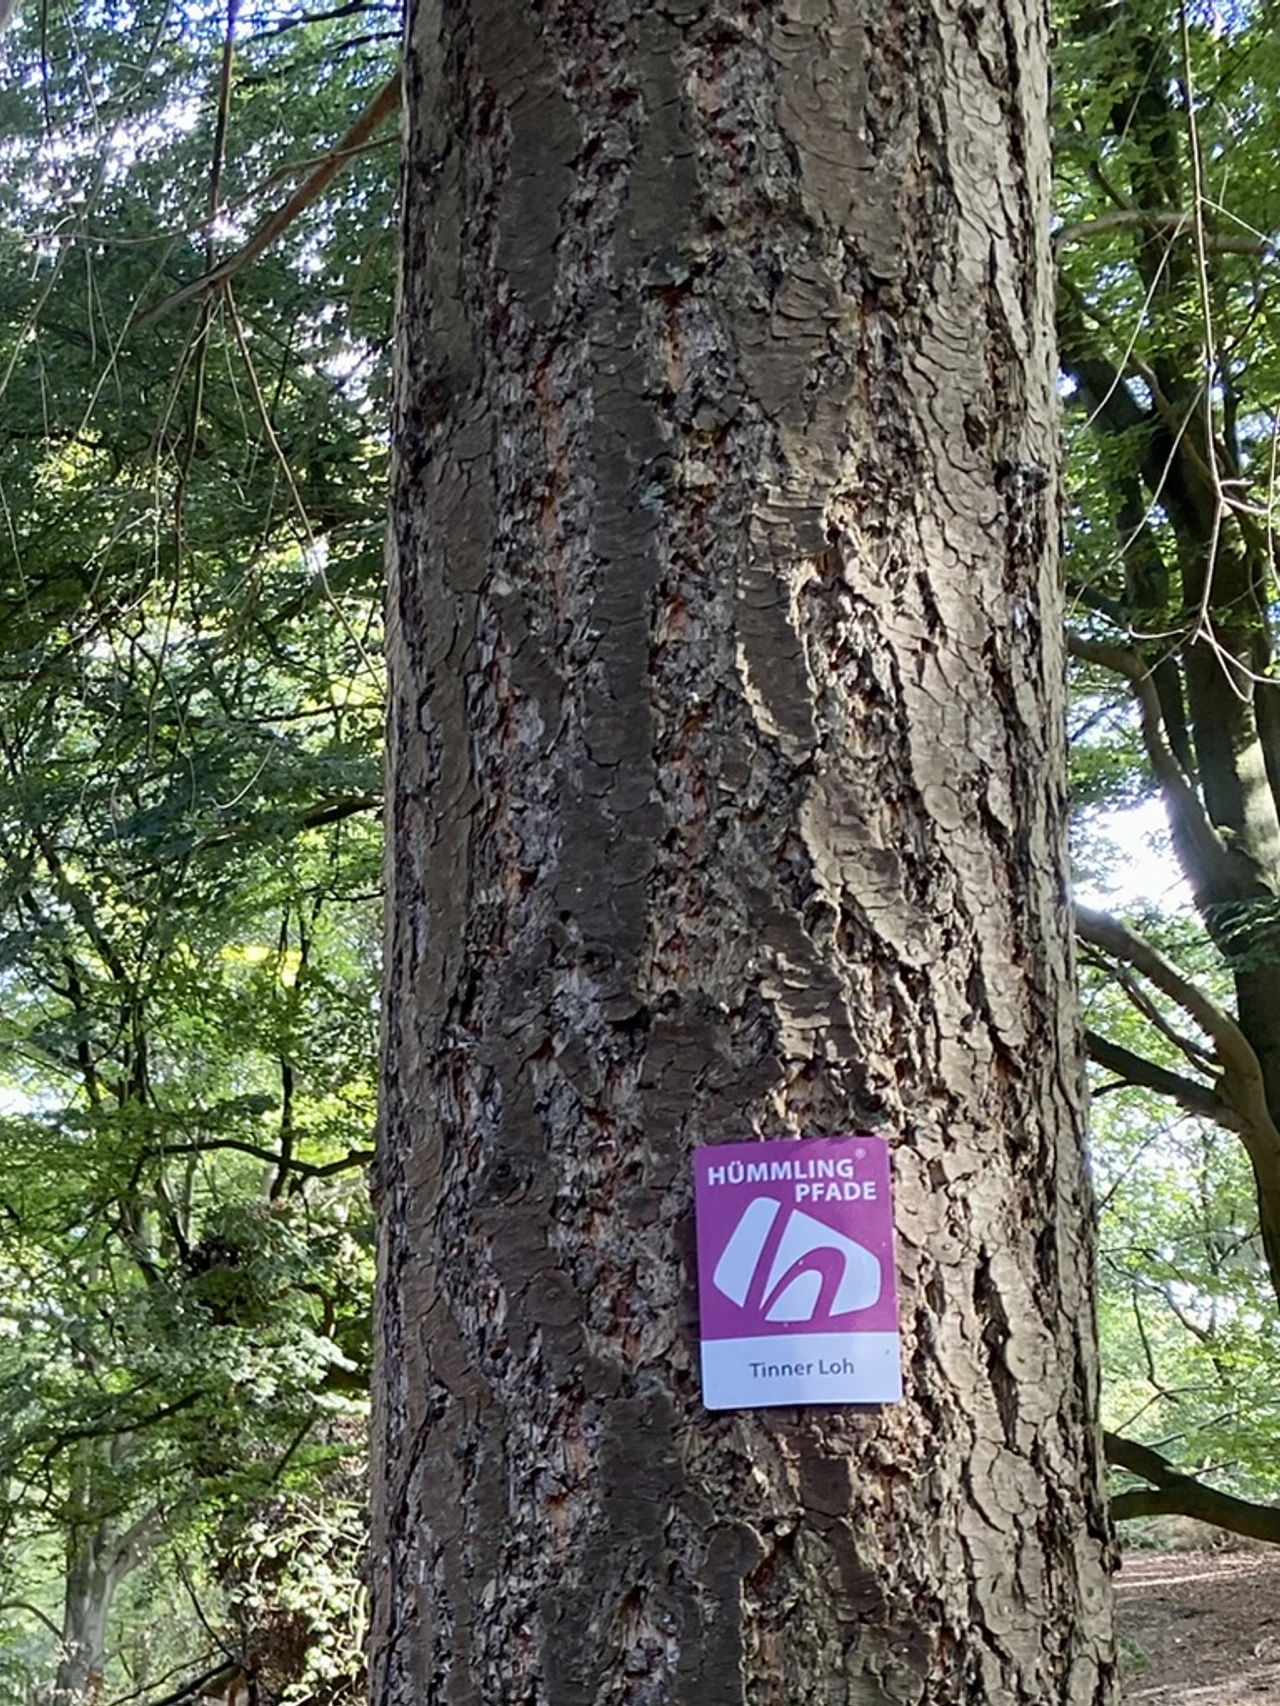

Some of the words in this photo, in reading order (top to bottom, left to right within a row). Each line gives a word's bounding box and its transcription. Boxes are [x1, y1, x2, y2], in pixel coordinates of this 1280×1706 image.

[707, 1158, 854, 1186] HÜMMLING
[794, 1181, 877, 1203] PFADE
[749, 1360, 814, 1379] Tinner
[818, 1357, 855, 1376] Loh
